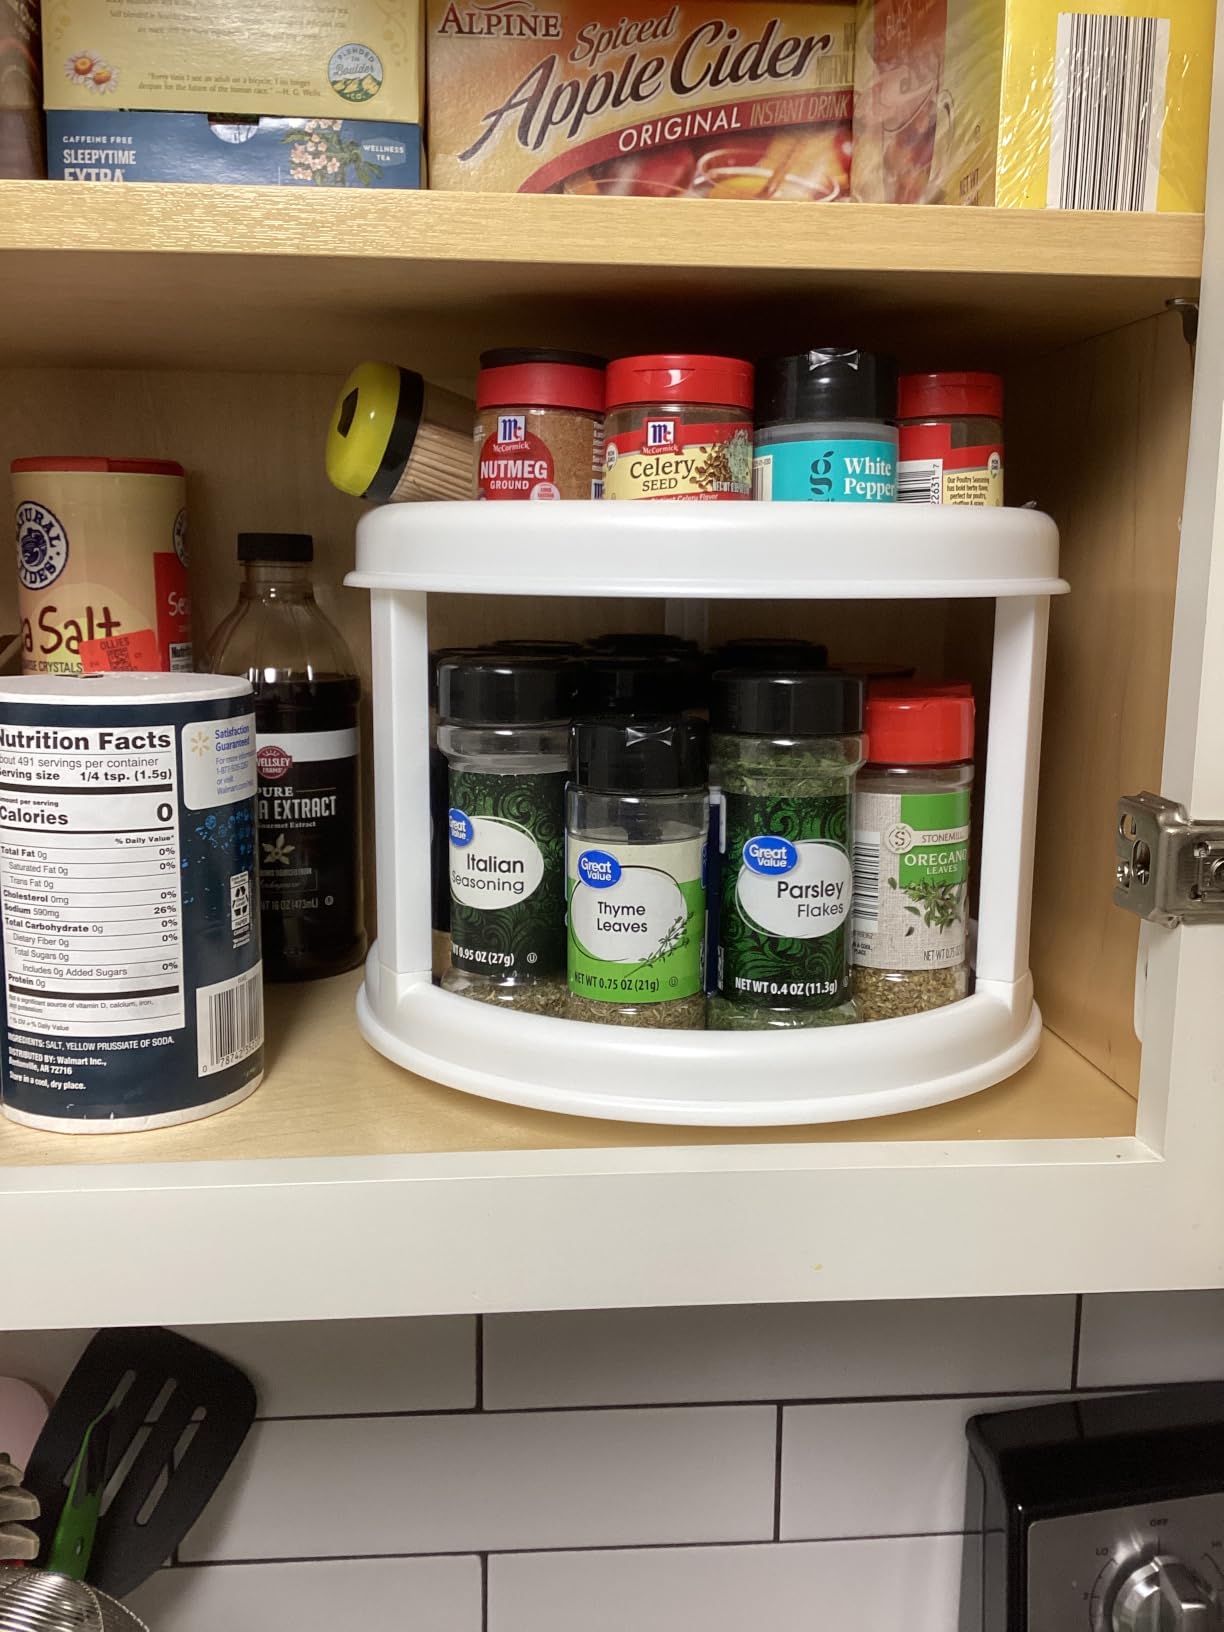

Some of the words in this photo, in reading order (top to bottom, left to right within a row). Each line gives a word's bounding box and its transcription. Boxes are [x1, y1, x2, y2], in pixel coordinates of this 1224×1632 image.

[438, 1, 561, 37] ALPINE
[569, 6, 678, 62] Spiced
[458, 55, 667, 162] Apple
[669, 19, 831, 94] Cider
[619, 108, 740, 152] ORIGINAL
[750, 98, 804, 126] INSTANT
[808, 94, 848, 119] DRINK
[63, 136, 107, 144] CAFFEINE
[63, 149, 136, 165] SLEEPYTIME
[363, 145, 405, 154] WELLNESS
[493, 441, 530, 453] McCormick
[642, 446, 678, 454] McCormick
[481, 460, 548, 479] NUTMEG
[630, 457, 695, 479] Celery
[844, 457, 891, 476] White
[490, 480, 529, 489] GROUND
[642, 478, 678, 492] SEED
[956, 477, 971, 485] Poultry
[844, 478, 895, 500] Pepper
[21, 562, 56, 584] IDES
[38, 605, 121, 655] Salt
[215, 725, 249, 739] Satisfaction
[98, 732, 171, 750] Facts
[216, 738, 250, 751] Guaranteed
[18, 757, 33, 766] 491
[38, 758, 81, 770] servings
[86, 760, 103, 769] per
[107, 757, 159, 768] container
[36, 770, 60, 780] size
[80, 772, 99, 782] 1/4
[104, 772, 130, 783] tsp.
[135, 769, 172, 782] (1.5g)
[0, 806, 68, 825] Calories
[157, 803, 173, 822] 0
[274, 796, 336, 819] EXTRACT
[125, 837, 146, 845] Daily
[1, 846, 19, 856] Total
[22, 849, 35, 857] Fat
[38, 851, 47, 860] 0g
[159, 847, 175, 856] 0%
[749, 844, 787, 860] Great
[904, 848, 967, 866] OREGANO
[9, 862, 41, 872] Saturated
[58, 867, 68, 876] 0g
[159, 862, 175, 870] 0%
[467, 853, 524, 873] Italian
[581, 857, 611, 874] Great
[757, 856, 787, 868] Value
[927, 864, 958, 875] LEAVES
[9, 876, 27, 885] Trans
[30, 879, 41, 887] Fat
[44, 880, 53, 889] 0g
[451, 870, 524, 894] Seasoning
[587, 870, 611, 881] Value
[3, 889, 48, 902] Cholesterol
[51, 896, 69, 905] 0mg
[161, 891, 176, 899] 0%
[777, 880, 844, 899] Parsley
[4, 903, 31, 914] Sodium
[33, 908, 59, 918] 590mg
[154, 905, 177, 914] 26%
[598, 901, 645, 918] Thyme
[797, 903, 843, 918] Flakes
[5, 917, 23, 927] Total
[25, 921, 89, 932] Carbohydrate
[92, 925, 103, 933] 0g
[162, 919, 178, 928] 0%
[597, 918, 647, 933] Leaves
[13, 933, 35, 944] Dietary
[37, 937, 56, 945] Fiber
[58, 939, 69, 947] 0g
[162, 934, 178, 942] 0%
[14, 947, 29, 956] Total
[31, 950, 56, 960] Sugars
[59, 953, 69, 962] 0g
[459, 947, 474, 960] 0.95
[475, 951, 487, 962] OZ
[488, 952, 514, 967] (27g)
[924, 950, 935, 961] NET
[936, 949, 944, 960] WT
[22, 964, 51, 974] Includes
[53, 968, 63, 977] 0g
[96, 968, 128, 977] Sugars
[162, 962, 178, 971] 0%
[8, 974, 34, 986] Protein
[36, 979, 46, 988] 0g
[575, 971, 584, 986] NET
[586, 974, 597, 987] WT
[599, 979, 618, 990] 0.75
[621, 979, 632, 991] OZ
[635, 979, 659, 992] (21g)
[735, 977, 751, 992] NET
[752, 982, 769, 994] WT
[771, 983, 788, 995] 0.4
[790, 983, 804, 995] OZ
[805, 979, 838, 996] (11.3g)
[109, 1001, 138, 1009] calcium,
[46, 1041, 64, 1050] SALT,
[65, 1042, 95, 1051] YELLOW
[97, 1040, 138, 1050] PRUSSIATE
[140, 1039, 150, 1047] OF
[152, 1036, 174, 1046] SODA.
[9, 1046, 43, 1062] DISTRIBUTED
[44, 1055, 56, 1063] BY:
[57, 1056, 88, 1065] Walmart
[90, 1057, 107, 1066] Inc.,
[40, 1064, 50, 1073] AR
[50, 1066, 72, 1075] 72716
[50, 1080, 62, 1090] dry
[63, 1081, 86, 1090] place.
